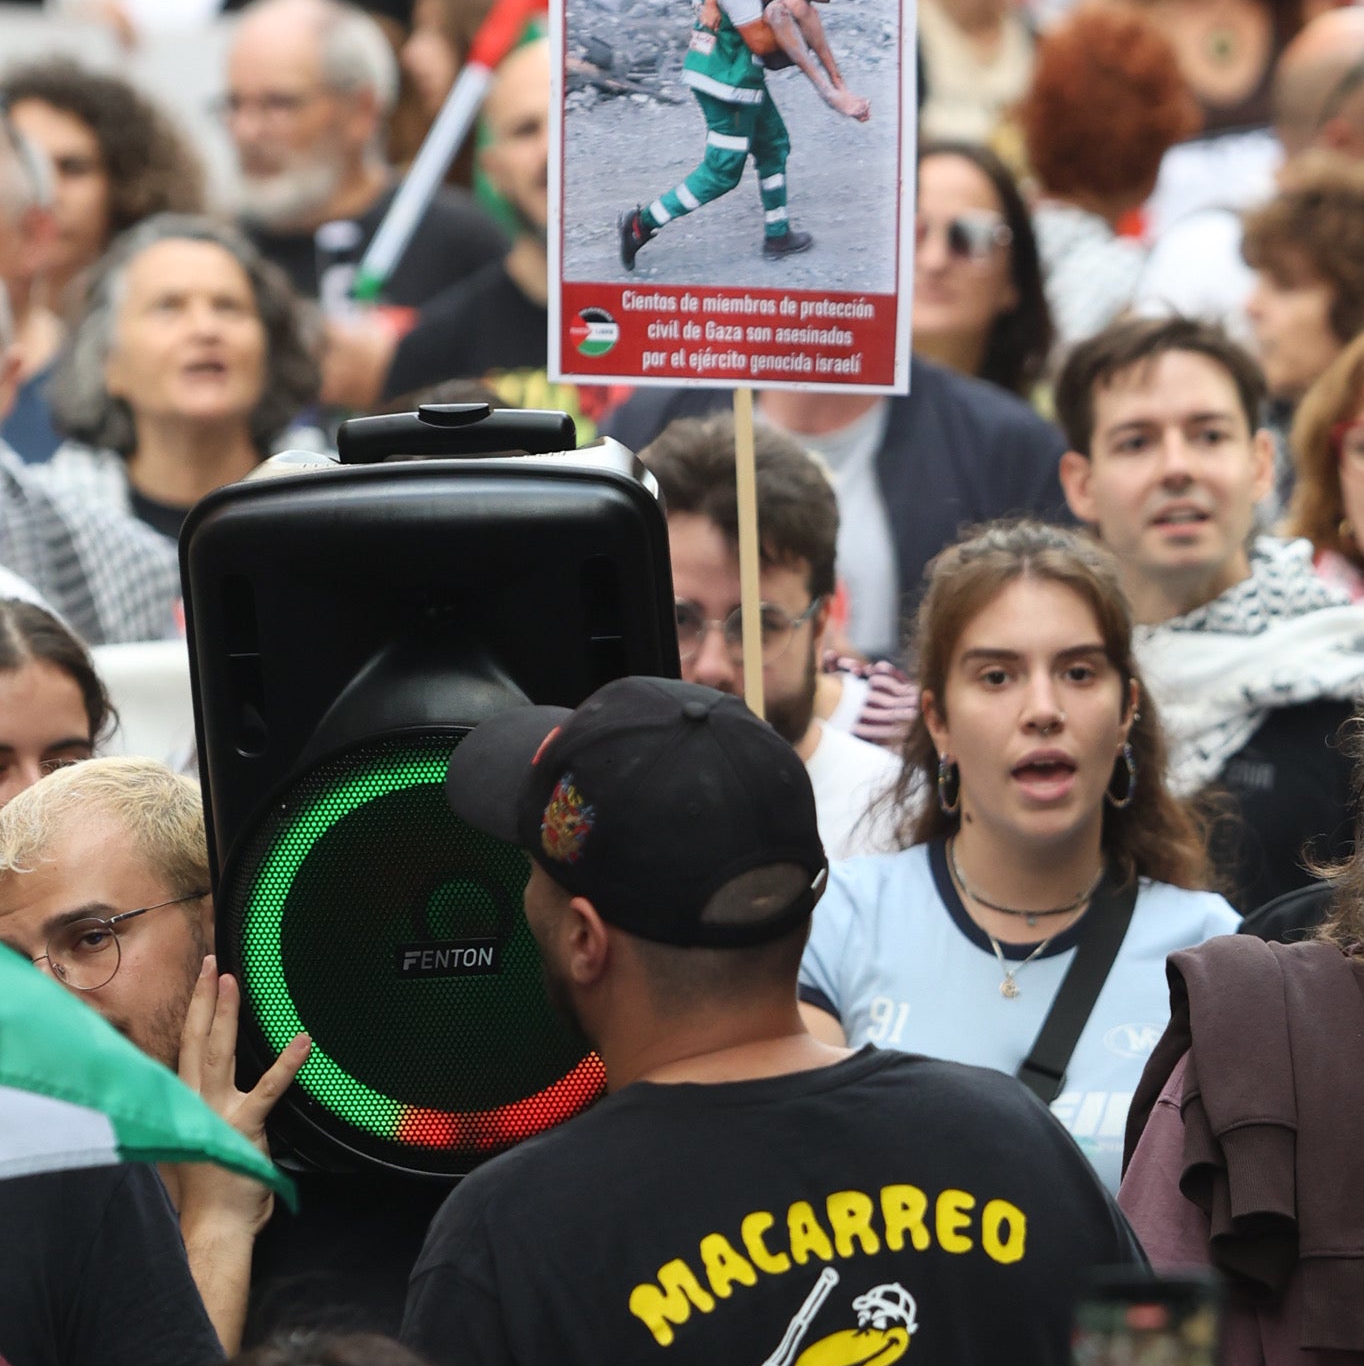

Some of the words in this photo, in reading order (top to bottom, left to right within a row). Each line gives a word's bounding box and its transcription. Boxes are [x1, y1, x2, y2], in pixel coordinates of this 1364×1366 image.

[622, 290, 677, 311] Cientos
[680, 292, 699, 312] de
[702, 293, 776, 315] miembros
[779, 295, 798, 315] de
[800, 297, 875, 320] protección
[647, 319, 680, 340] civil
[682, 320, 702, 340] de
[705, 320, 743, 342] Gaza
[746, 326, 772, 343] son
[775, 324, 853, 347] asesinados
[642, 351, 668, 371] por
[670, 348, 686, 368] el
[688, 347, 747, 373] ejército
[750, 352, 813, 375] genocida
[815, 352, 863, 374] israelí
[402, 946, 494, 971] FENTON
[866, 996, 910, 1043] 91
[628, 1183, 1026, 1347] MACARREO
